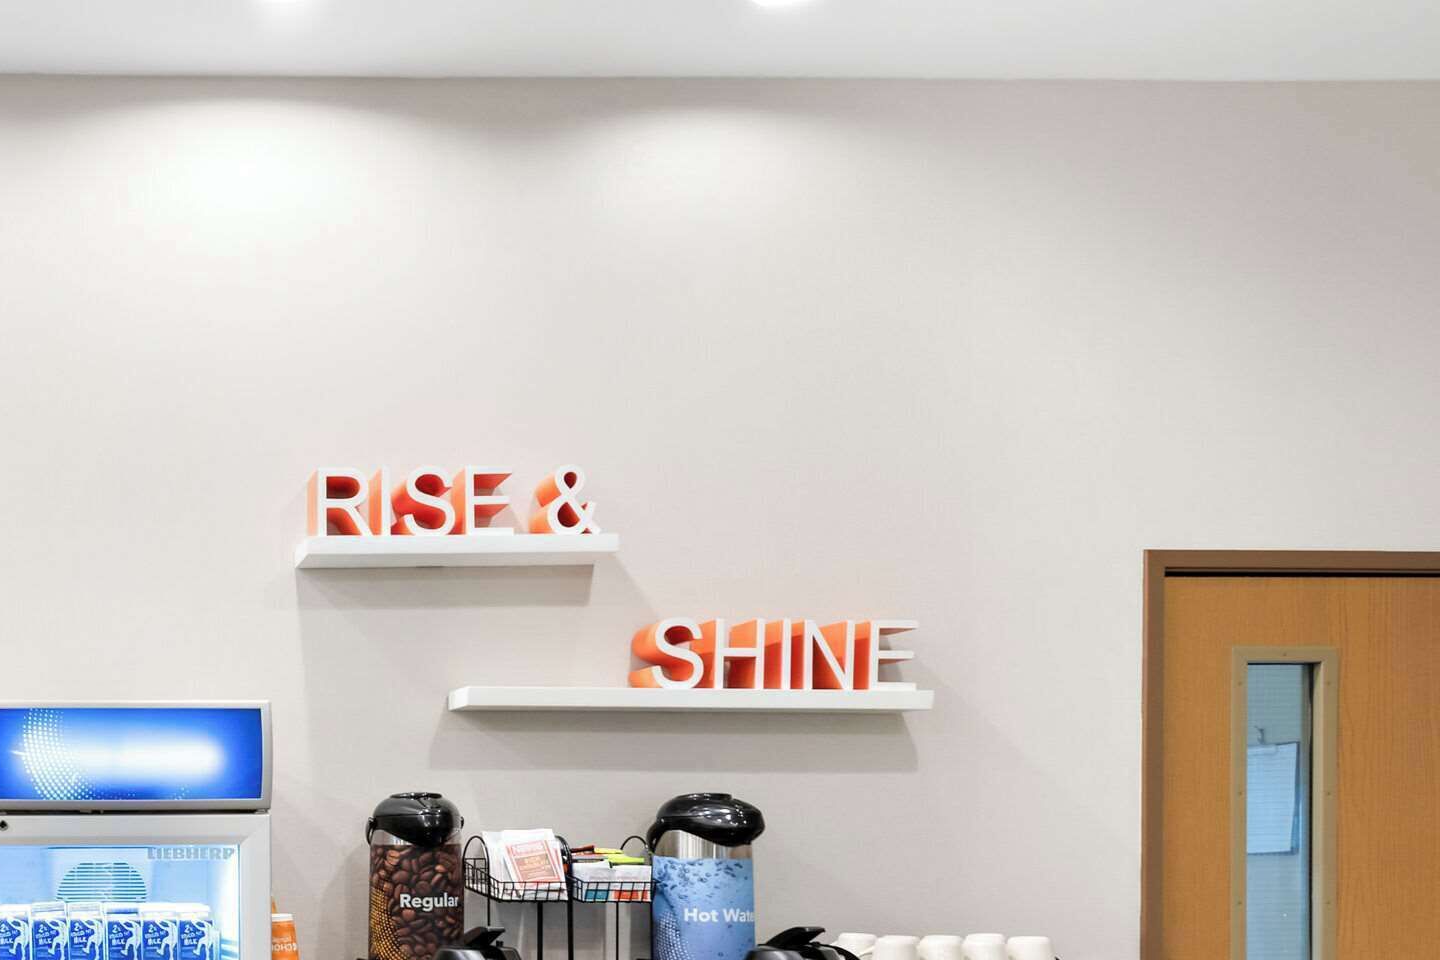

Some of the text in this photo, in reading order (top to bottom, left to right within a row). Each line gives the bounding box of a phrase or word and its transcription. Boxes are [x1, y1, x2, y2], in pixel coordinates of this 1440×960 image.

[313, 464, 602, 536] RISE &
[646, 617, 918, 691] SHINE
[399, 893, 459, 912] Regular
[684, 908, 719, 922] Hot
